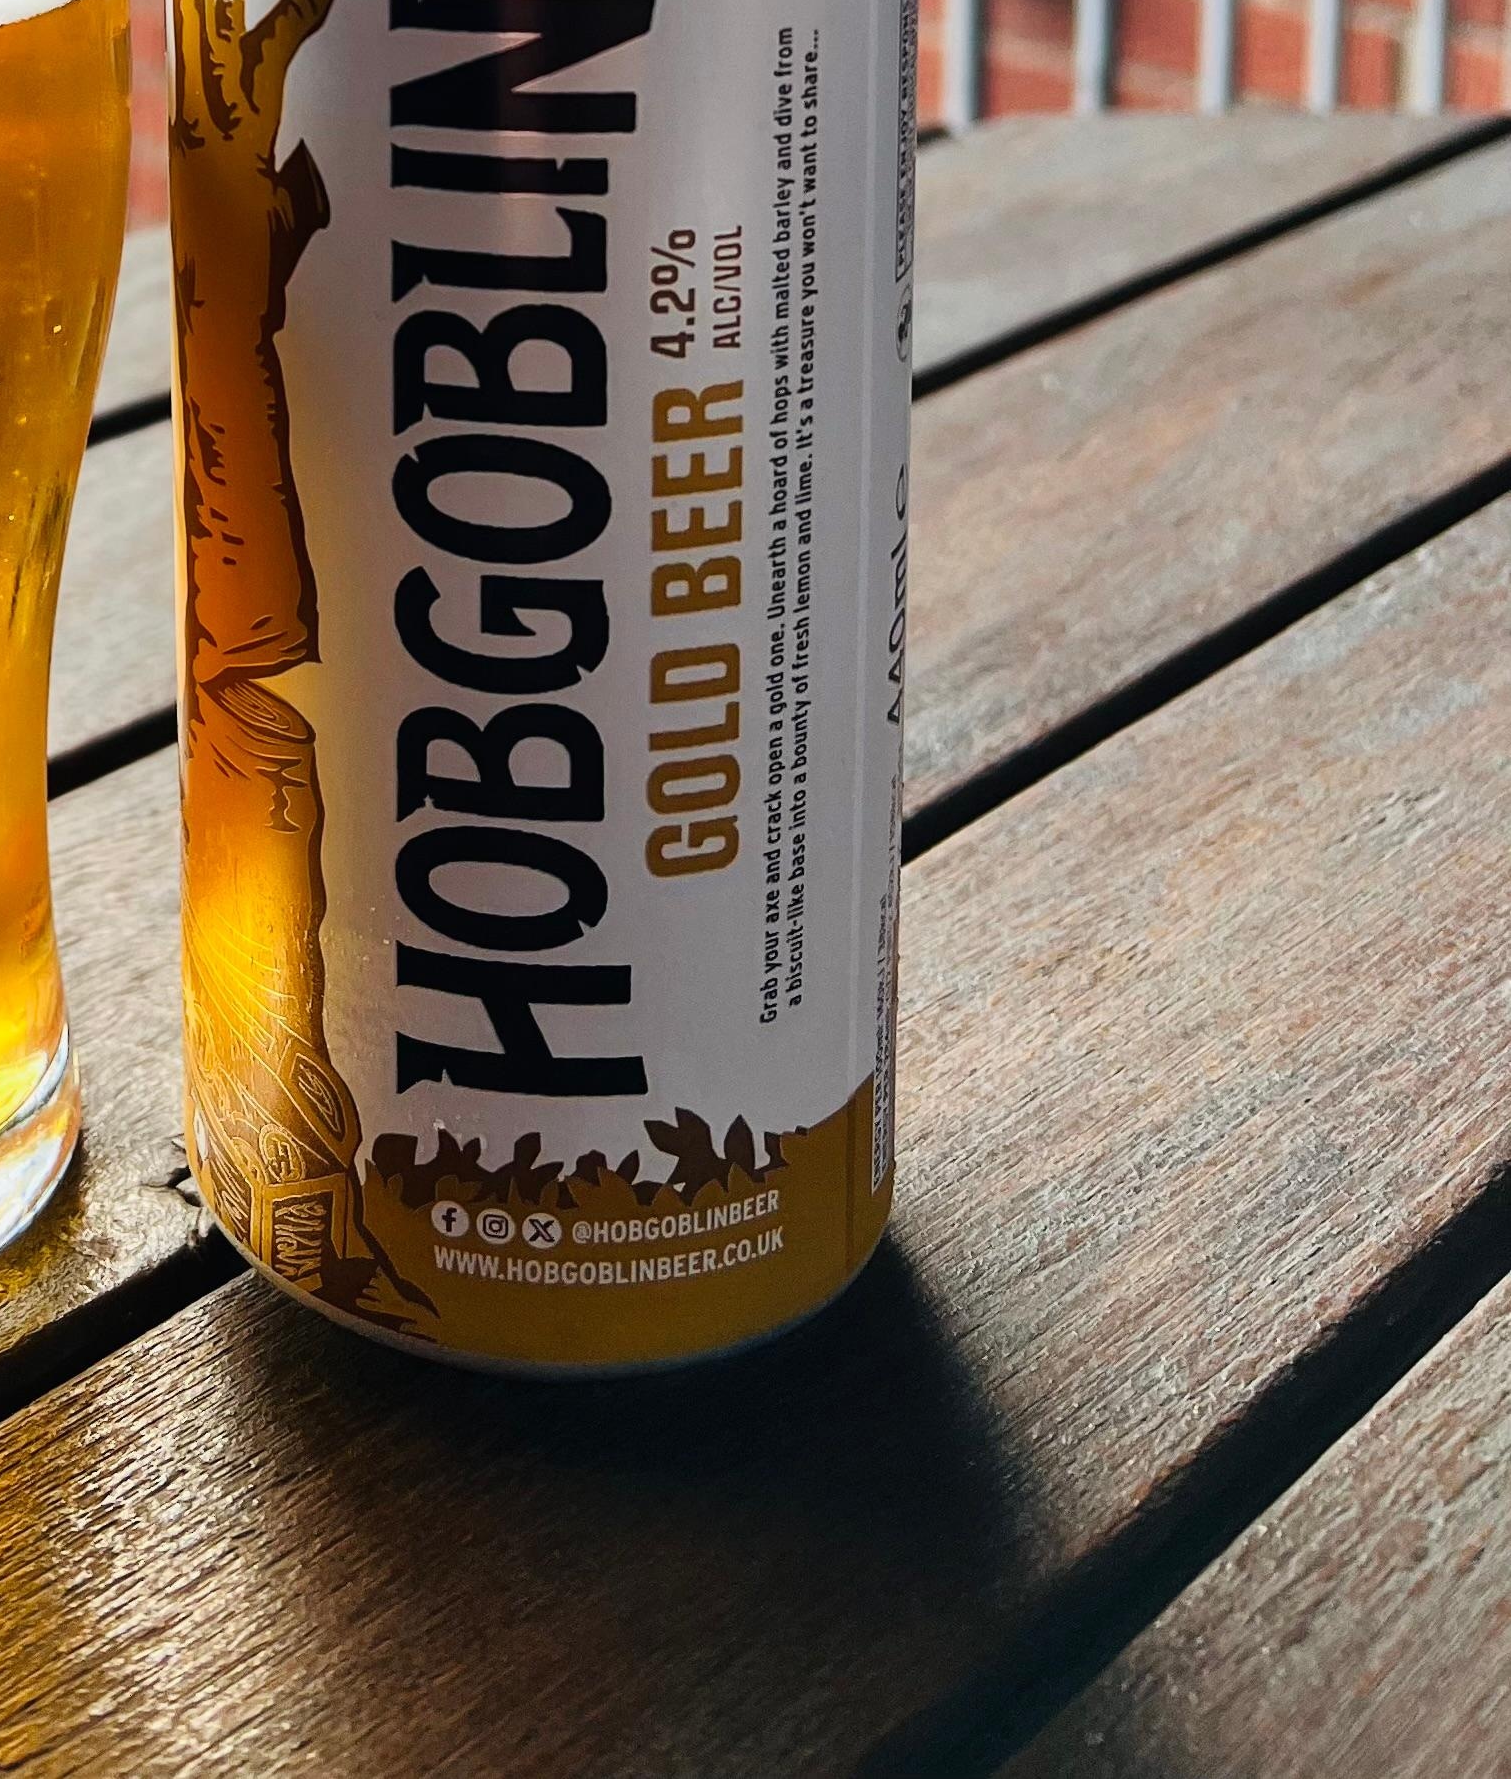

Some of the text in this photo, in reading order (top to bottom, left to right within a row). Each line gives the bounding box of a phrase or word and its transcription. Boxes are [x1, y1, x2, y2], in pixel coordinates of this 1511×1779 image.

[649, 228, 697, 360] 4.2%
[712, 224, 743, 349] ALC/VOL
[759, 27, 795, 1024] Grab your axe and crack open a gold one. Unearth a hoard of hops with malted barley and dive from
[784, 28, 819, 1007] a biscuit-like base into a bounty of fresh lemon and lime. It's a treasure you won't want to share...
[645, 379, 744, 878] GOLD BEER
[886, 528, 907, 726] 440ml
[432, 1226, 785, 1286] WWW.HOBGOBLINBEER.CO.UK
[571, 1189, 780, 1245] @HOBGOBLINBEER
